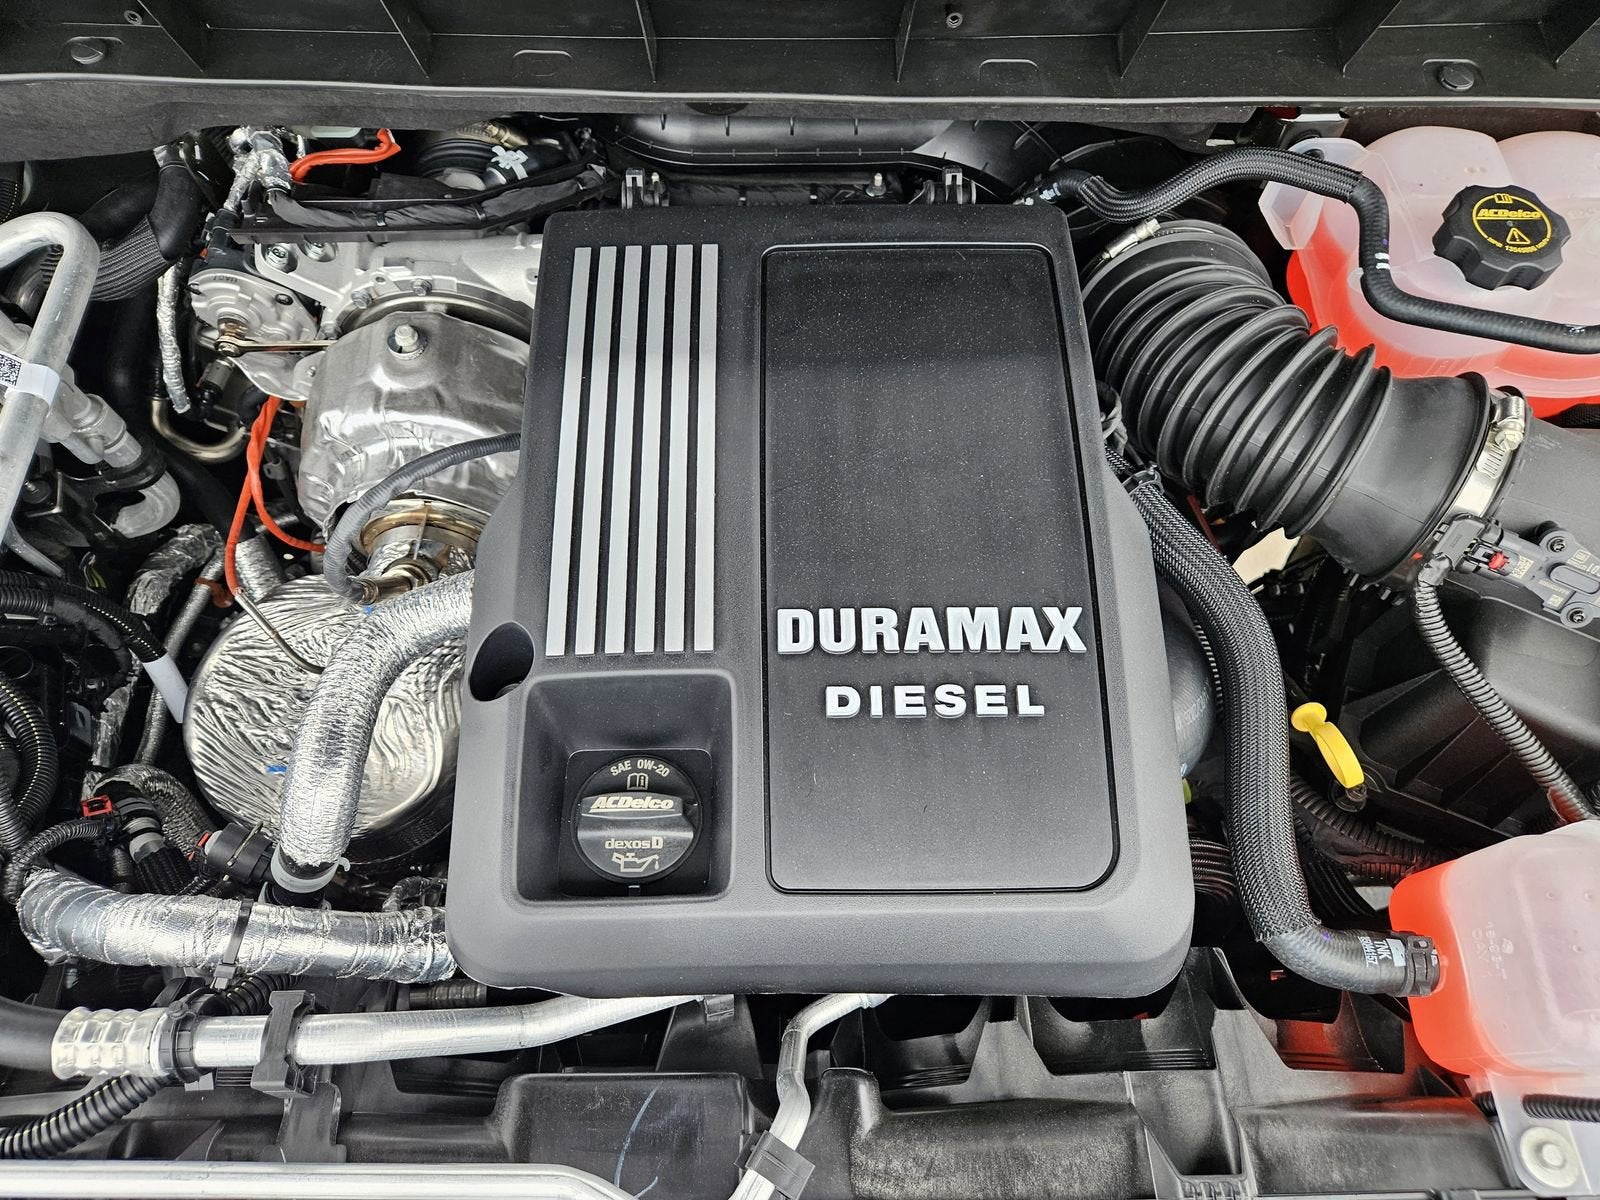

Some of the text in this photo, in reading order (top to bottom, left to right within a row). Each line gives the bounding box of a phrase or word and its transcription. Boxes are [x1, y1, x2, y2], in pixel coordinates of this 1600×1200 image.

[1477, 208, 1542, 219] ACDelco
[777, 606, 1087, 654] DURAMAX
[825, 684, 1045, 718] DIESEL
[610, 759, 670, 777] SAE 0W-20
[590, 796, 675, 811] ACDelco
[605, 836, 664, 849] dexosD
[1373, 939, 1393, 961] TNK
